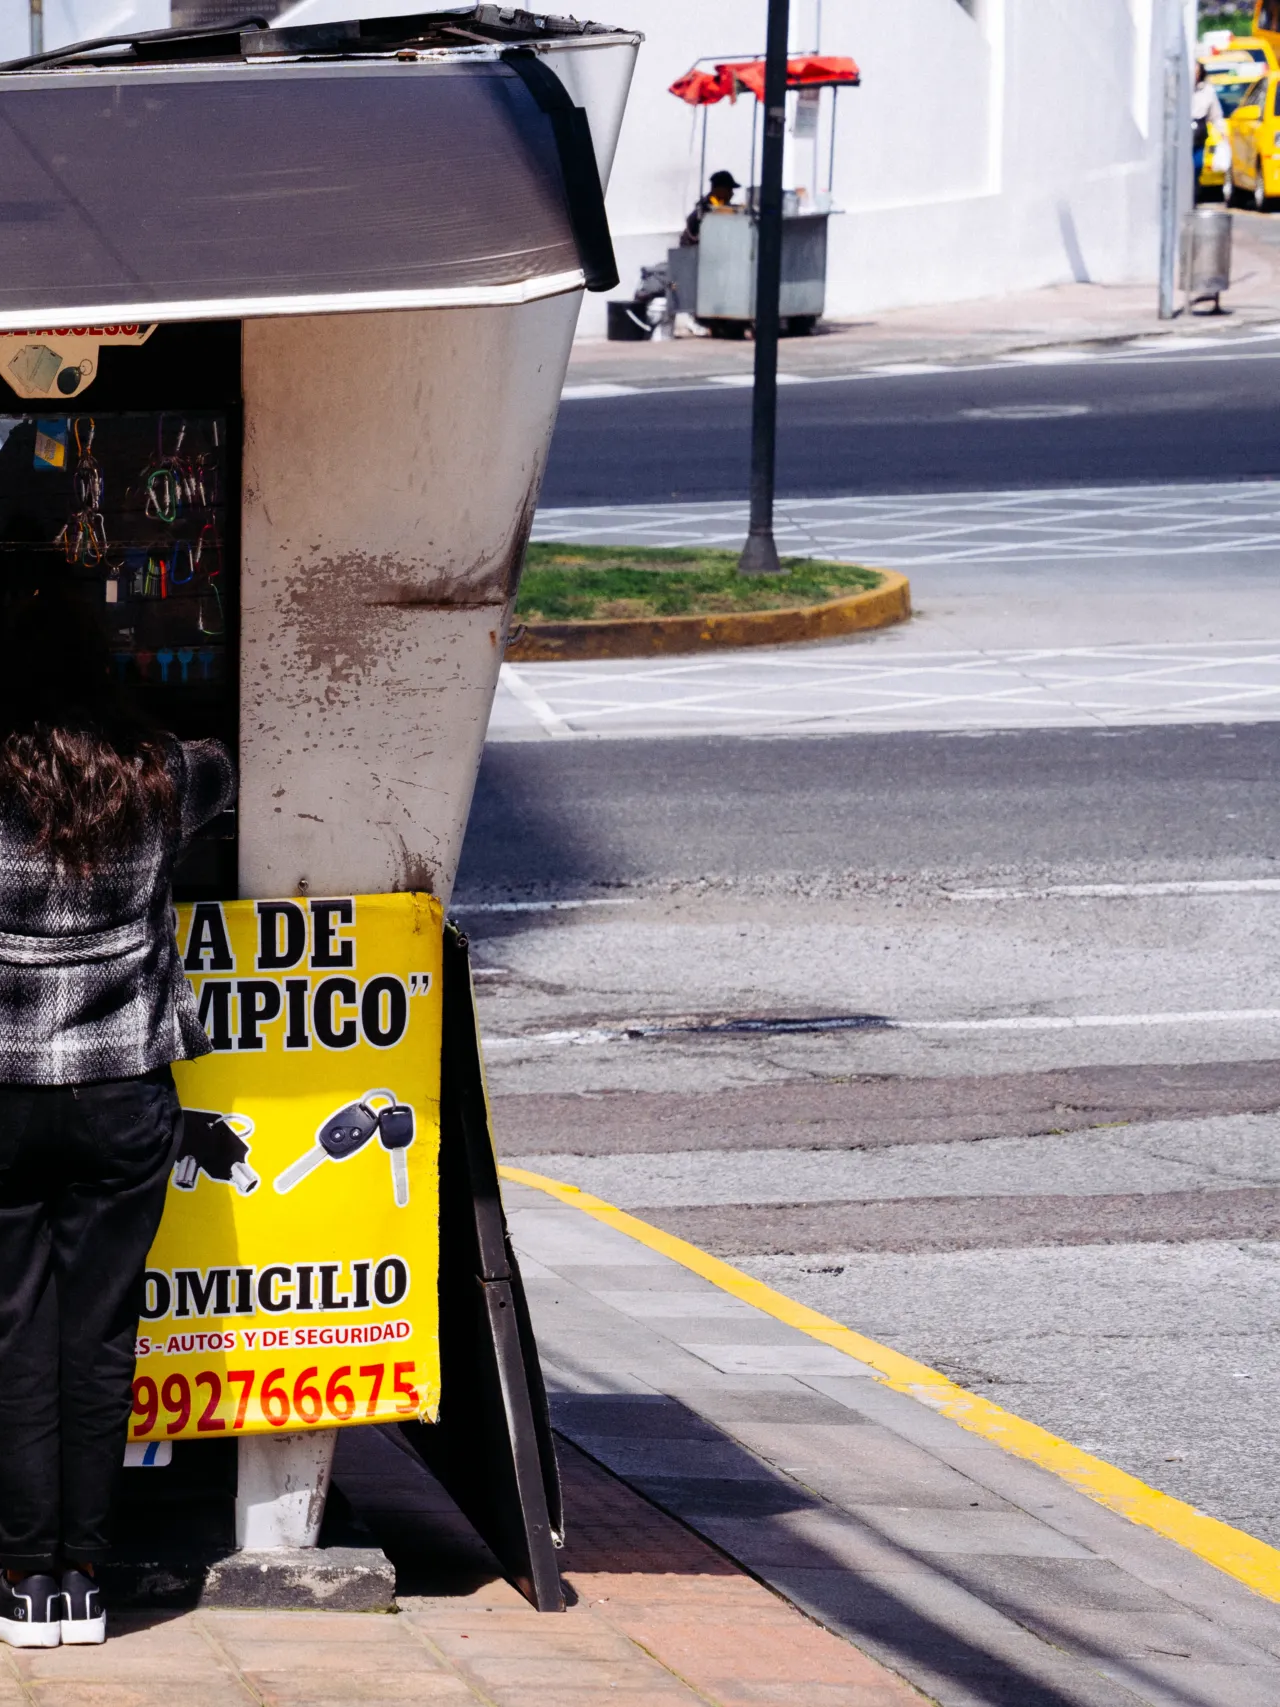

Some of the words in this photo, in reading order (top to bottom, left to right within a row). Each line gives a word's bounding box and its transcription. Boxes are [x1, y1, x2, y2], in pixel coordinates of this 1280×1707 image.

[180, 901, 236, 973] A
[254, 897, 356, 971] DE
[138, 1257, 409, 1320] OMICILIO
[167, 1332, 236, 1353] AUTOS
[243, 1332, 257, 1348] Y
[263, 1330, 289, 1347] DE
[295, 1321, 411, 1346] SEGURIDAD
[130, 1361, 420, 1437] 992766675
